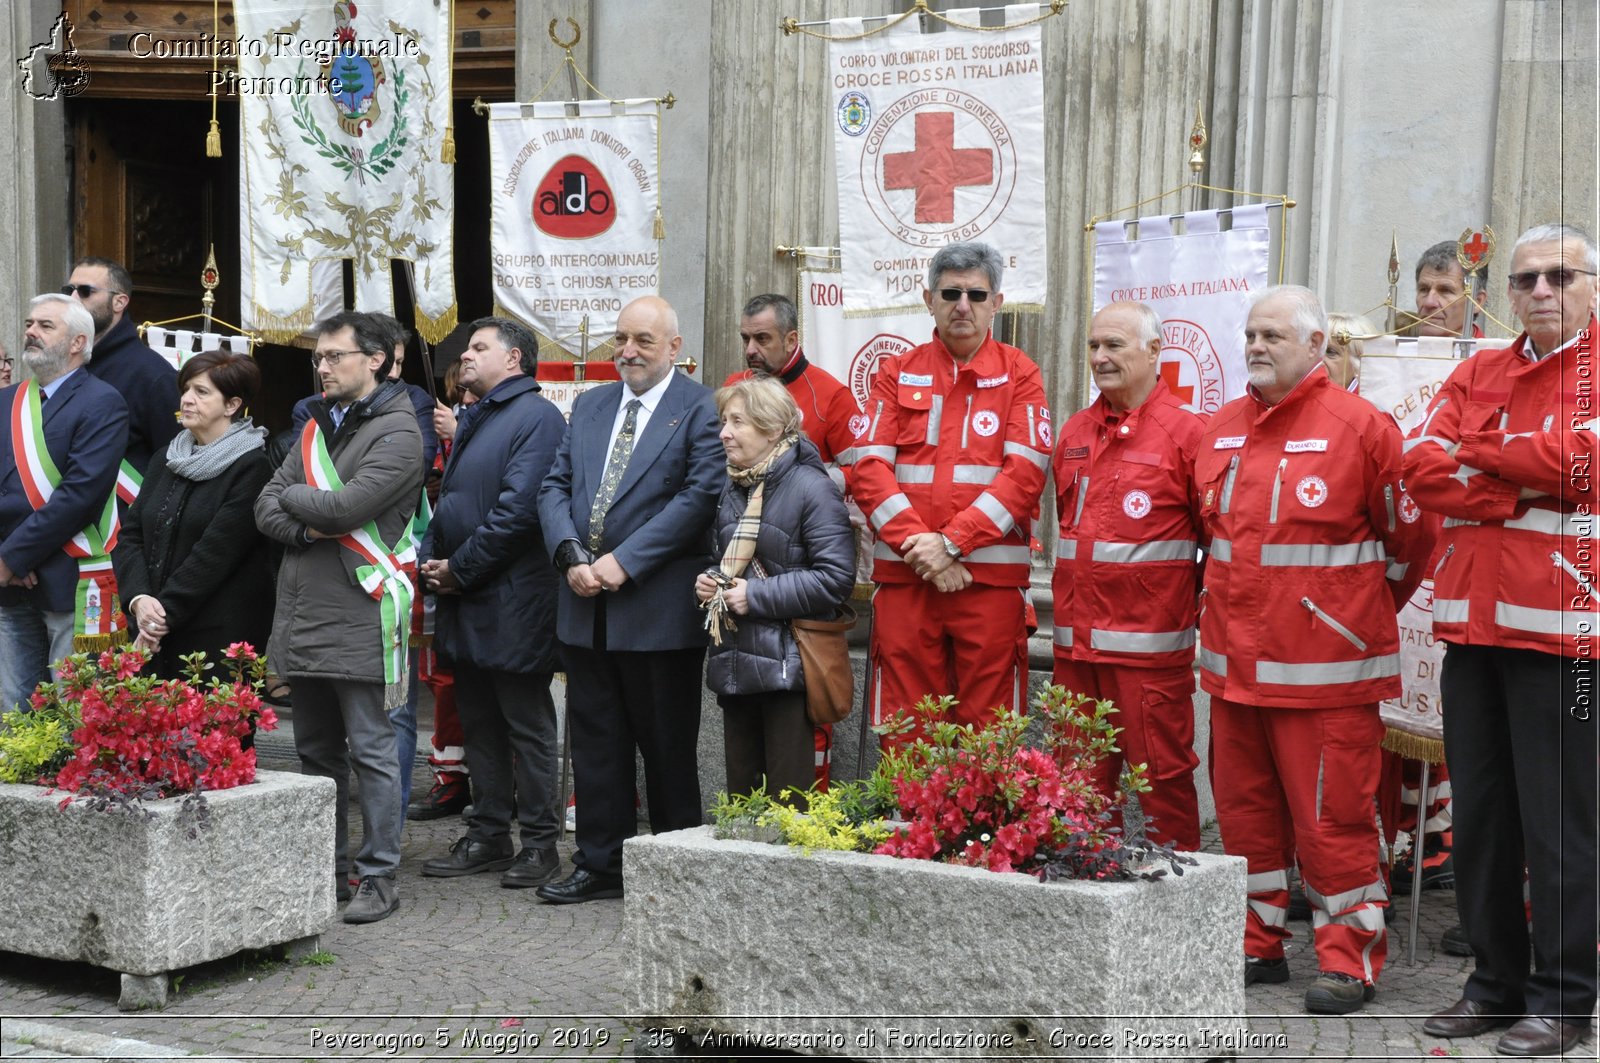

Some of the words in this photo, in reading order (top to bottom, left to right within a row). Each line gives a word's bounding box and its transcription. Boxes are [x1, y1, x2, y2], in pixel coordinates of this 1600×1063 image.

[840, 55, 876, 69] CORPO
[881, 49, 940, 66] VOLONTARI
[946, 47, 965, 61] DEL
[972, 41, 1030, 59] SOCCORSO
[835, 71, 891, 89] CROCE
[898, 67, 956, 84] ROSSA
[963, 59, 1038, 80] ITALIANA
[866, 90, 938, 155] CONVENZIONE
[946, 92, 961, 103] DI
[964, 98, 1009, 148] GINEVRA
[502, 138, 541, 198] ASSOCIAZIONE
[542, 127, 585, 146] ITALIANA
[590, 129, 632, 161] DONATORI
[627, 158, 651, 193] ORGANI
[495, 254, 545, 268] GRUPPO
[550, 252, 657, 268] INTERCOMUNALE
[496, 275, 542, 290] BOVES
[561, 275, 613, 289] CHIUSA
[619, 274, 657, 289] PESIO
[887, 273, 926, 293] MOR
[1111, 286, 1147, 303] CROCE
[1151, 283, 1188, 299] ROSSA
[1191, 277, 1249, 296] ITALIANA
[533, 298, 622, 312] PEVERAGNO
[1162, 326, 1205, 358] NEVRA
[1203, 378, 1221, 414] AGO
[1400, 627, 1434, 648] TATO
[1417, 660, 1436, 681] DI
